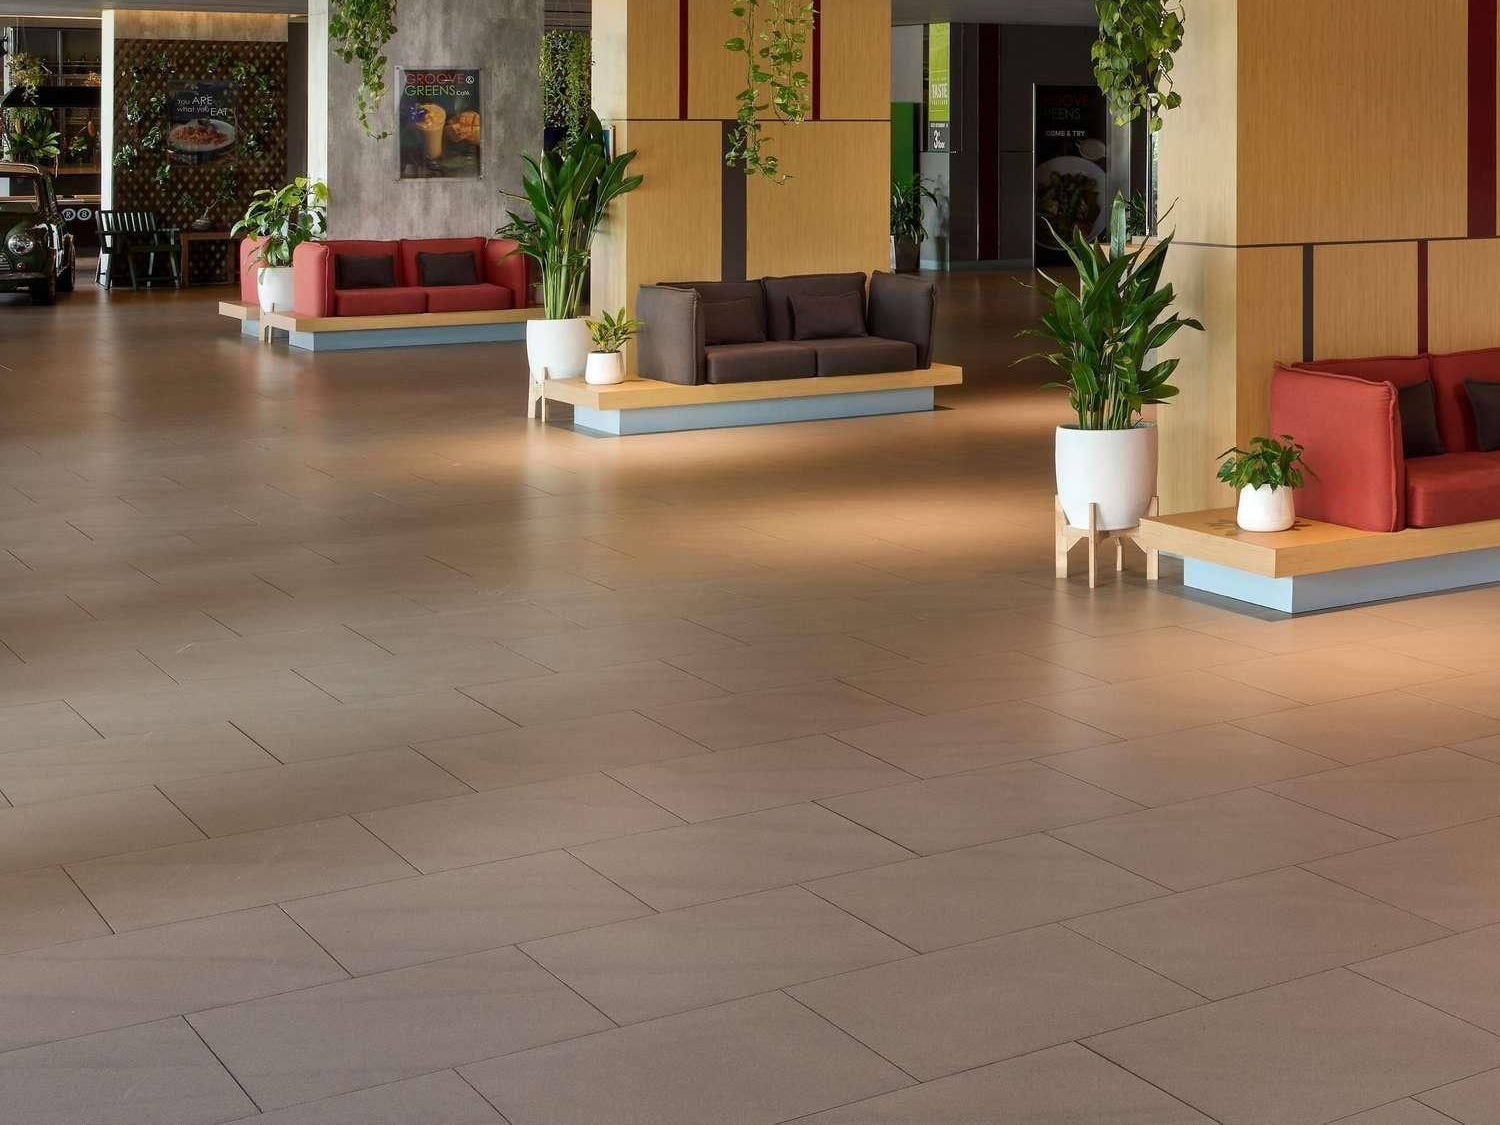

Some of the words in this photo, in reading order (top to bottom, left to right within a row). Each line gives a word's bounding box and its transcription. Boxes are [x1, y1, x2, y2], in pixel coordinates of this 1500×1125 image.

[405, 73, 465, 85] GROOVE
[404, 84, 456, 96] GREENS
[191, 96, 213, 105] ARE
[210, 107, 228, 116] EAT
